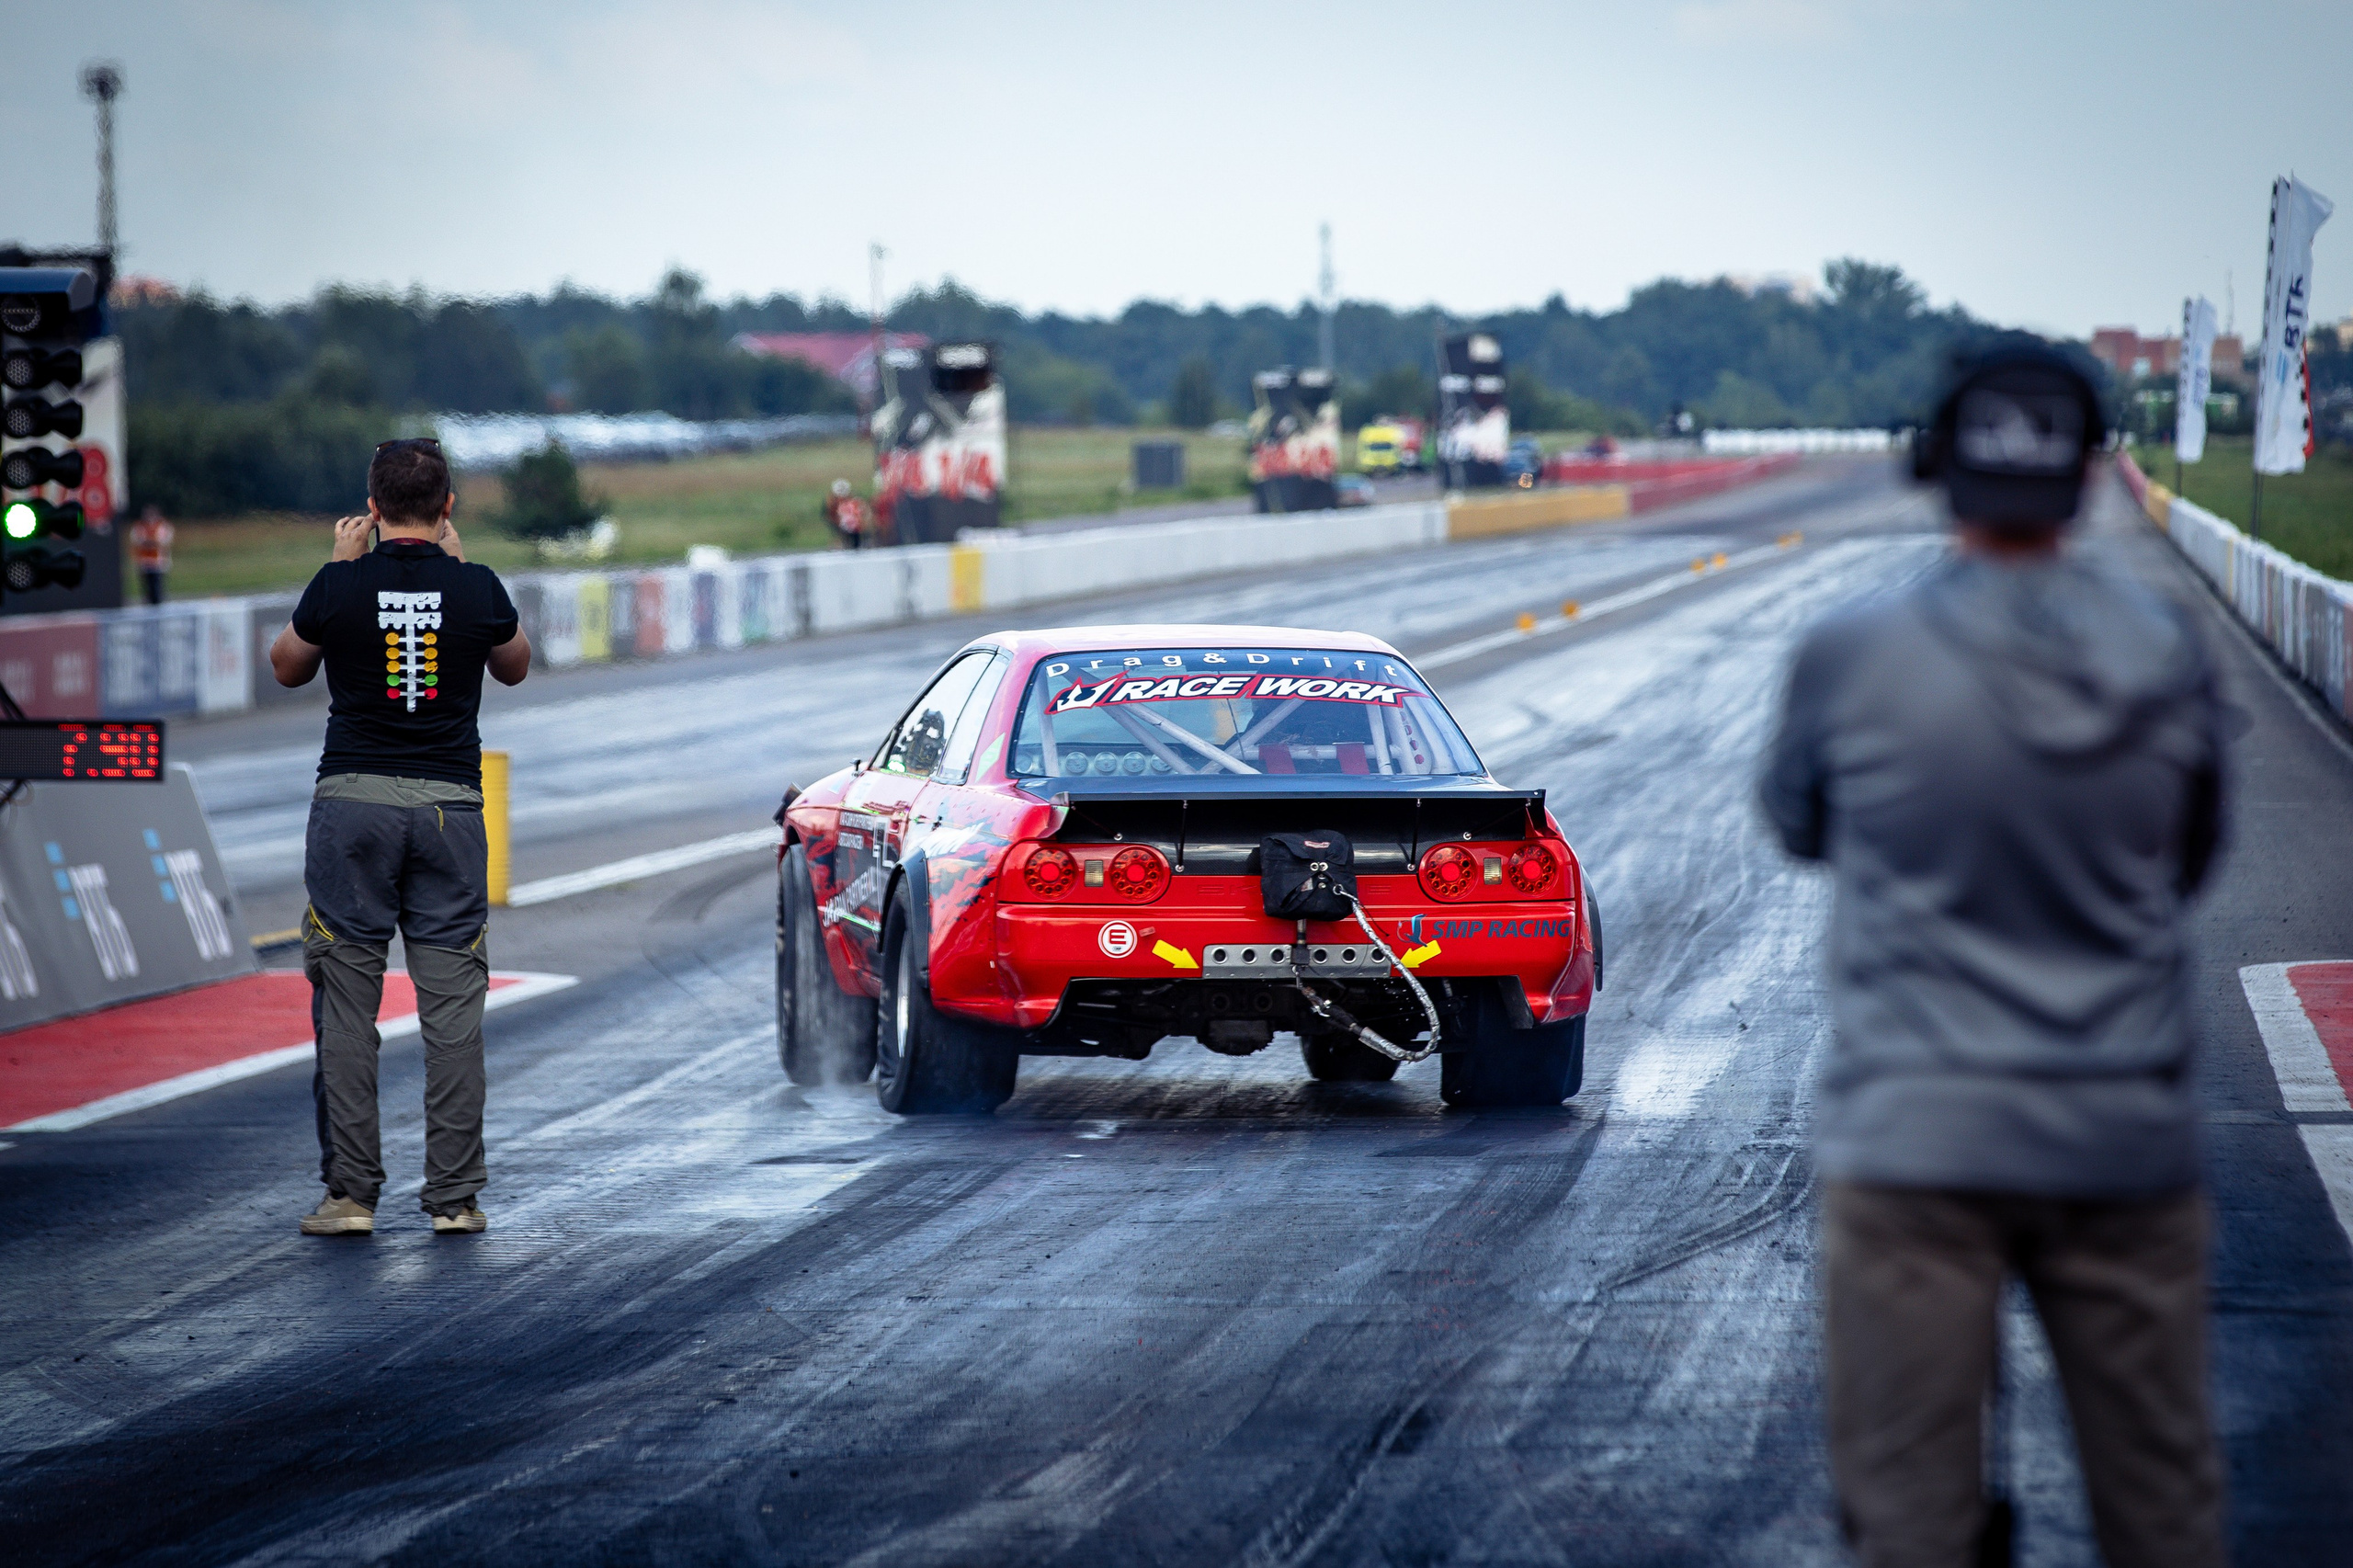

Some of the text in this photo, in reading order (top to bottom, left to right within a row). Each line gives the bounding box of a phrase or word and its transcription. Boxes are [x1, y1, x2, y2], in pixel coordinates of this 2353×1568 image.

[1109, 676, 1409, 703] RACE WORK
[58, 723, 159, 777] 7.90
[1431, 920, 1571, 938] SMP RACING
